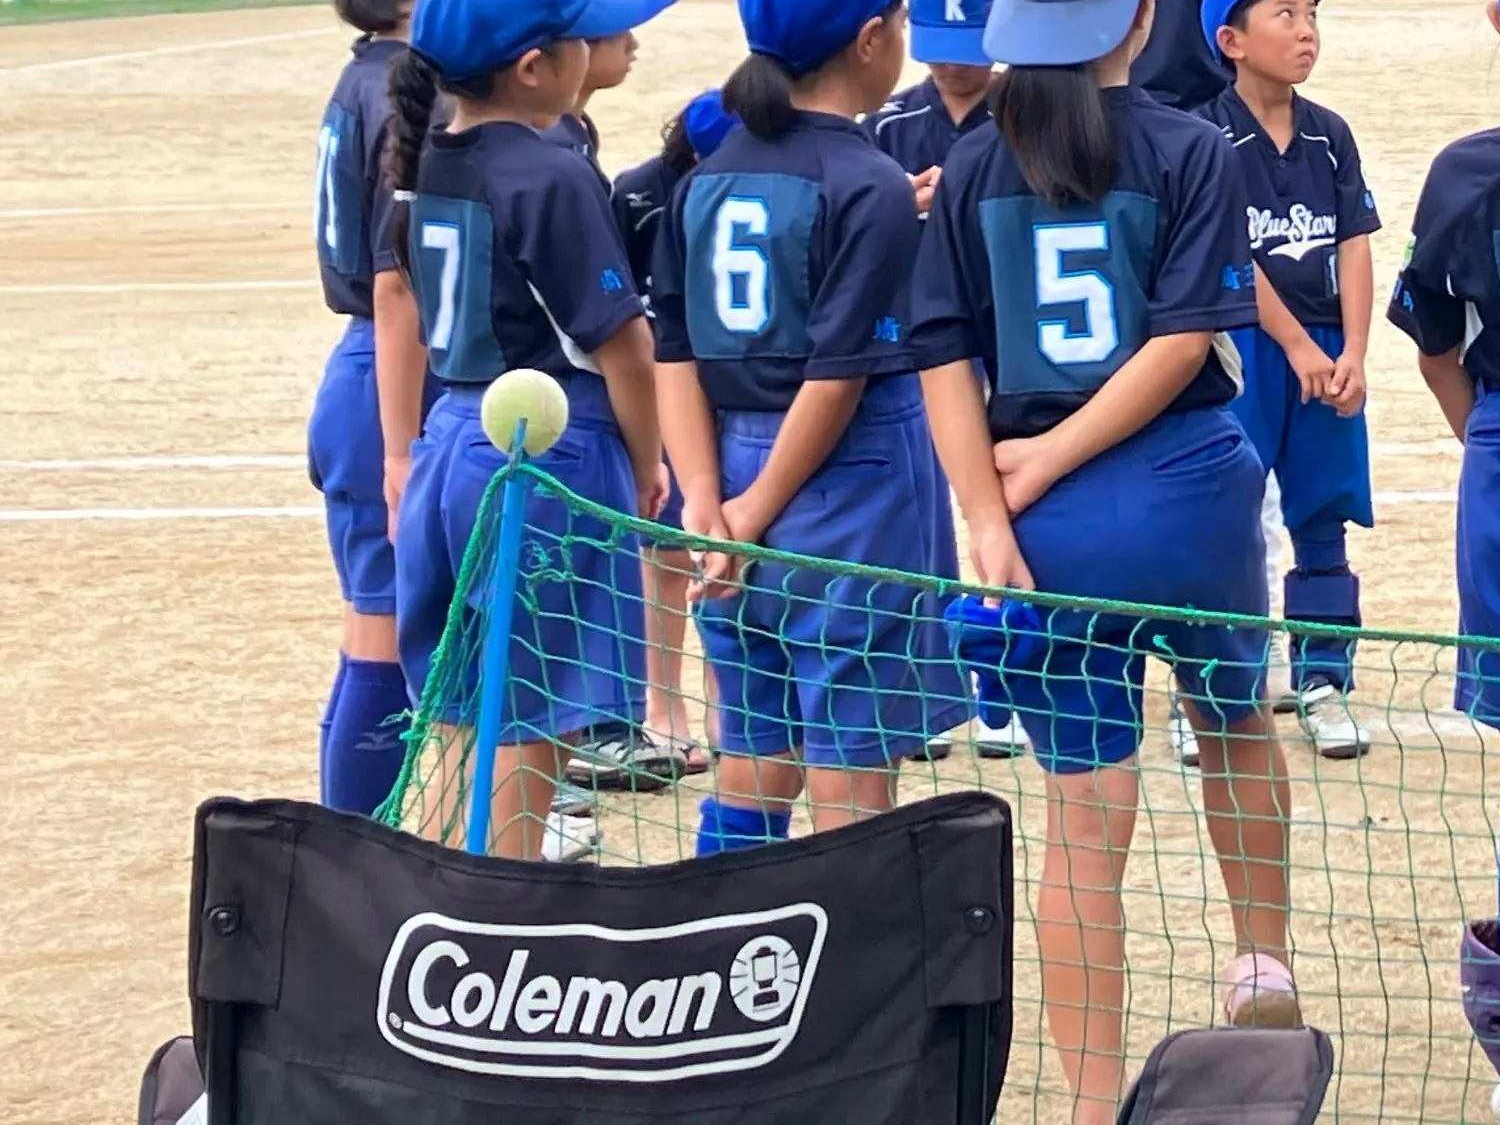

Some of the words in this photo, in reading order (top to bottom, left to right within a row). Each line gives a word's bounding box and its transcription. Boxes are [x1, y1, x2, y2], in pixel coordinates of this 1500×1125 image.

[421, 221, 461, 351] 7
[712, 195, 770, 334] 6
[1246, 206, 1291, 249] Blue
[1287, 203, 1337, 245] Star
[1033, 219, 1120, 367] 5
[408, 940, 722, 1038] Coleman
